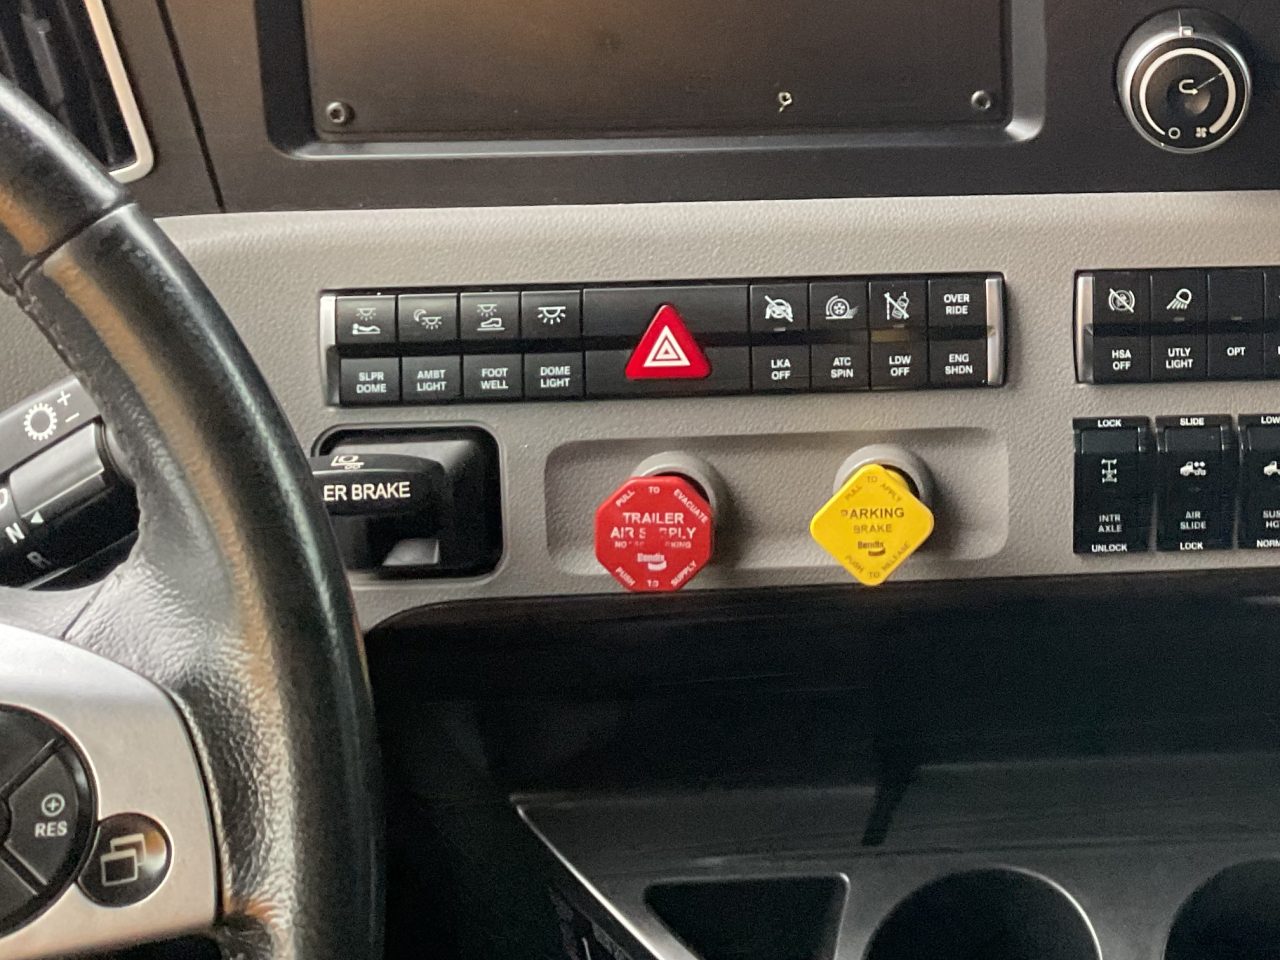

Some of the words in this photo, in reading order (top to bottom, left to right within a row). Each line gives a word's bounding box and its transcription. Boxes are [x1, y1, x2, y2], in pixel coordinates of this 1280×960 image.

[943, 293, 970, 304] OVER
[945, 305, 968, 315] RIDE
[1111, 349, 1132, 360] HSA
[1168, 347, 1191, 358] UTLY
[1226, 346, 1246, 356] OPT
[771, 358, 791, 369] LKA
[832, 356, 851, 367] ATC
[889, 355, 912, 366] LDW
[948, 353, 970, 364] ENG
[1165, 358, 1193, 369] LIGHT
[540, 366, 571, 376] DOME
[890, 366, 910, 377] OFF
[944, 365, 973, 375] SHDN
[1112, 361, 1131, 371] OFF
[358, 371, 384, 382] SLPR
[416, 369, 446, 380] AMBT
[481, 367, 508, 378] FOOT
[771, 370, 791, 381] OFF
[830, 368, 854, 379] SPIN
[416, 381, 447, 392] LIGHT
[481, 379, 509, 390] WELL
[540, 377, 570, 388] LIGHT
[356, 383, 386, 394] DOME
[1097, 418, 1122, 428] LOCK
[1179, 416, 1205, 426] SLIDE
[867, 475, 878, 484] TO
[351, 481, 411, 501] BRAKE
[615, 489, 636, 508] PULL
[648, 486, 661, 495] TO
[673, 488, 710, 524] EVACUATE
[622, 512, 685, 525] TRAILER
[840, 507, 905, 520] PARKING
[1098, 514, 1121, 523] INTR
[1185, 510, 1201, 520] AIR
[853, 523, 893, 534] BRAKE
[1098, 524, 1123, 533] AXLE
[1179, 521, 1206, 530] SLIDE
[5, 522, 25, 544] N
[610, 526, 635, 539] AIR
[1091, 543, 1128, 553] UNLOCK
[1179, 541, 1204, 551] LOCK
[615, 566, 636, 587] PUSH
[647, 579, 660, 588] TO
[670, 560, 697, 587] SUPPLY
[34, 820, 68, 838] RES
